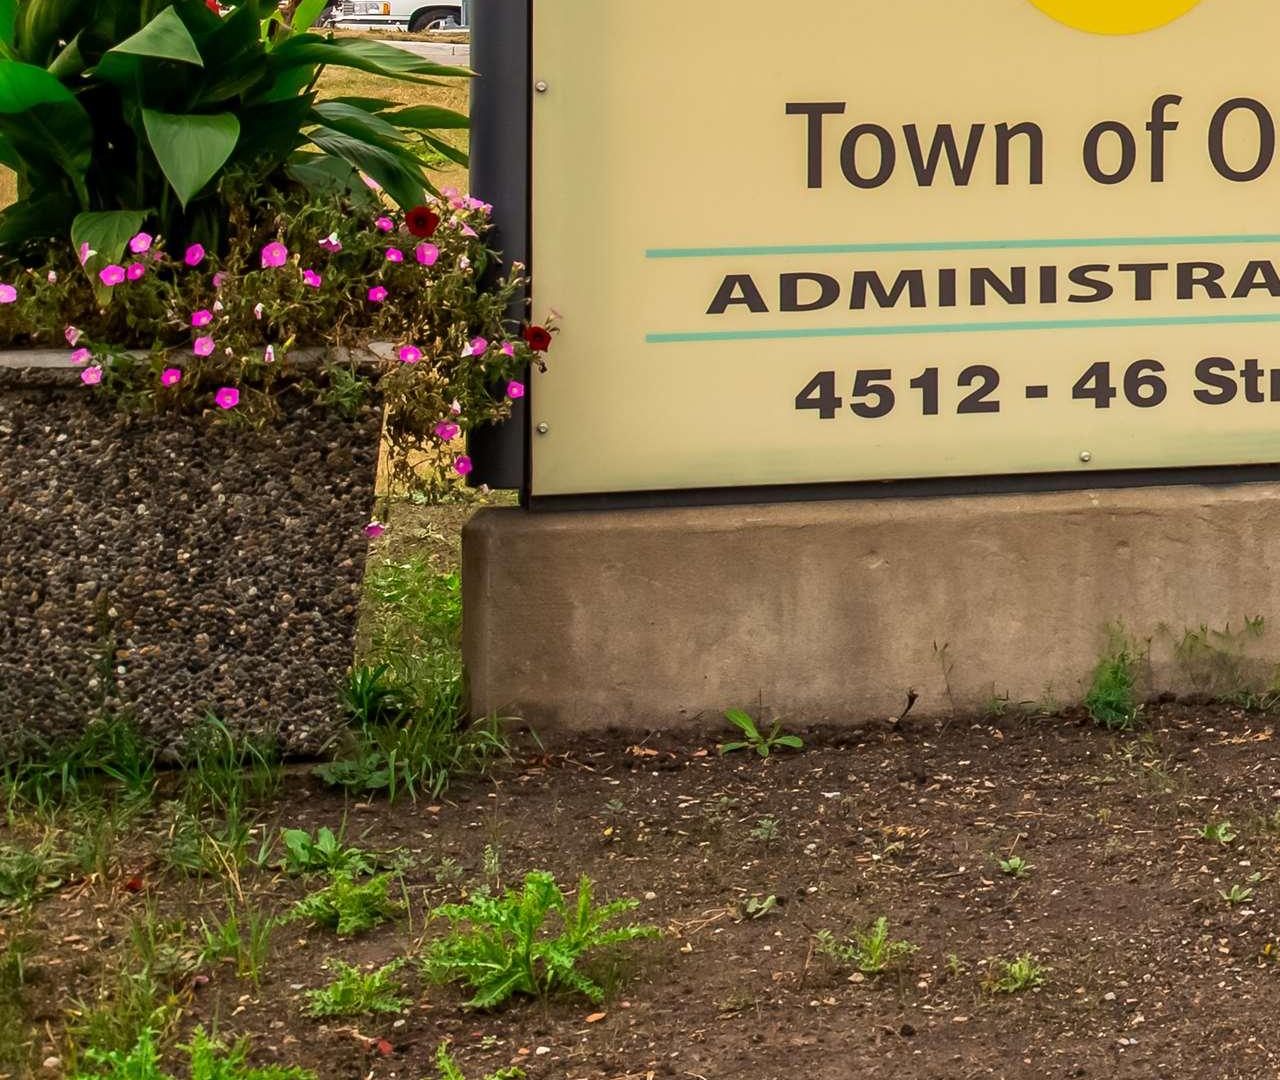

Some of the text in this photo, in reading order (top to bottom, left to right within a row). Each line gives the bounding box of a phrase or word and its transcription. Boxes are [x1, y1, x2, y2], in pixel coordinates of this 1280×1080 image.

[785, 101, 1044, 190] Town
[1082, 94, 1183, 184] of
[794, 364, 1001, 420] 4512
[1071, 358, 1168, 409] 46
